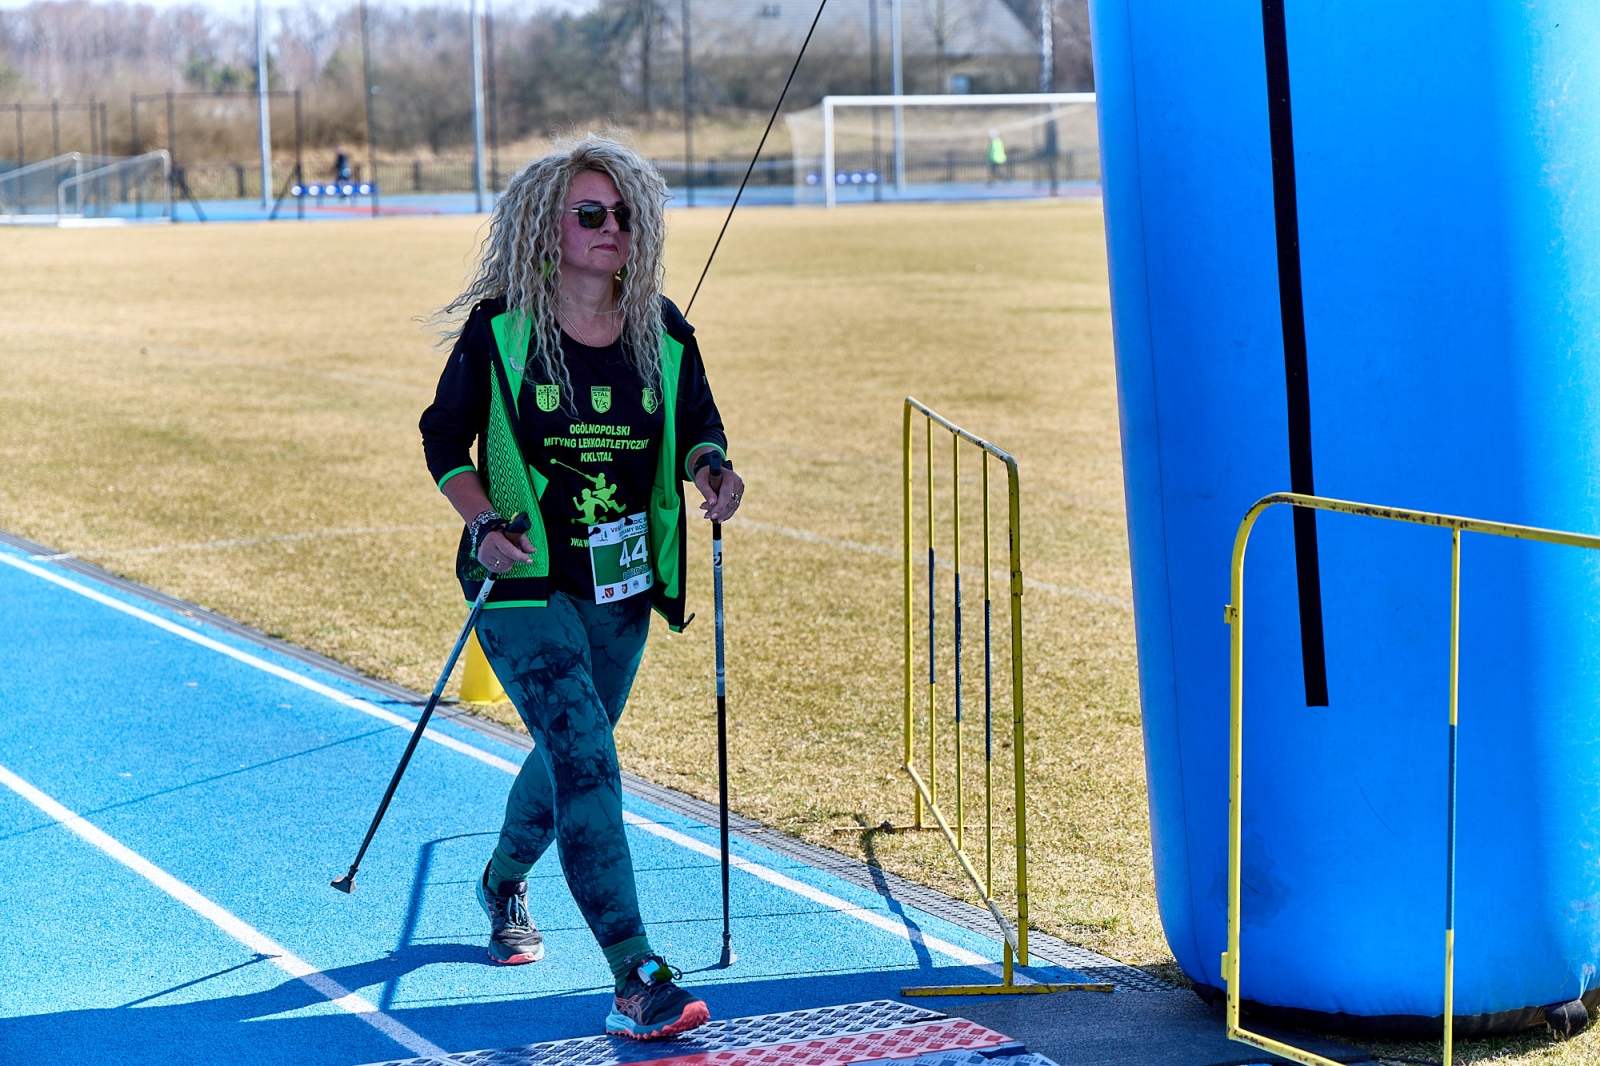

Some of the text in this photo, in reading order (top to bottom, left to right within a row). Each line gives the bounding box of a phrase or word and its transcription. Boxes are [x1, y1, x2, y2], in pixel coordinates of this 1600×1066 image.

[569, 422, 631, 436] OGÓLNOPOLSKI
[544, 437, 577, 449] MITYNG
[619, 535, 649, 568] 44
